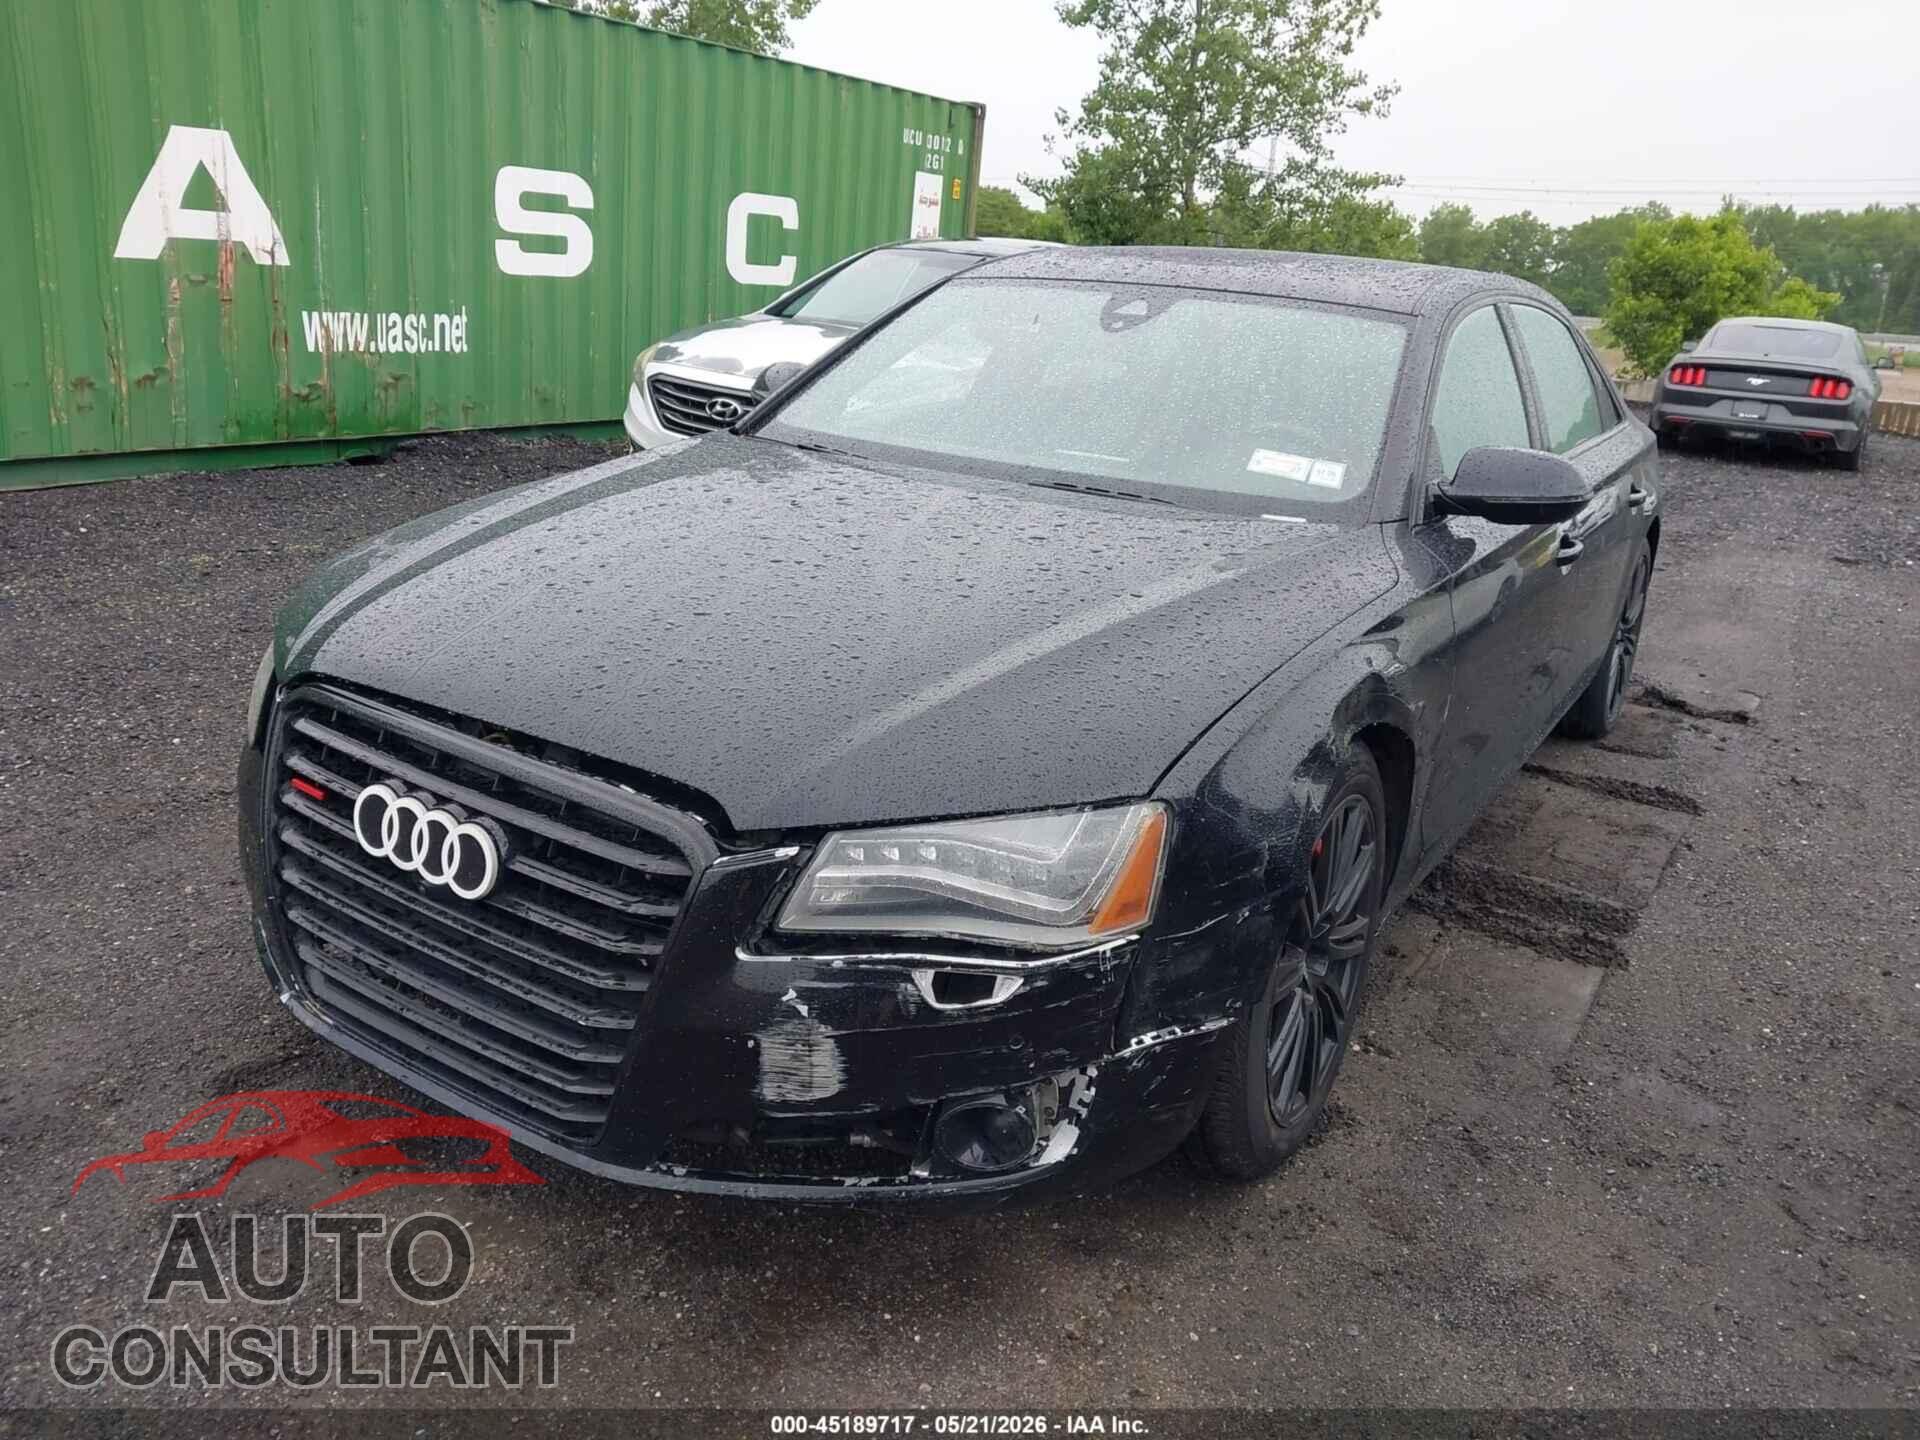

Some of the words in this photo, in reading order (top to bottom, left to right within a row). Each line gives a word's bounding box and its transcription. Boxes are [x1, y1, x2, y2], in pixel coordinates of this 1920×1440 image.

[113, 125, 291, 266] A
[494, 165, 594, 278] S
[725, 191, 799, 287] C
[301, 295, 469, 354] www.uasc.net
